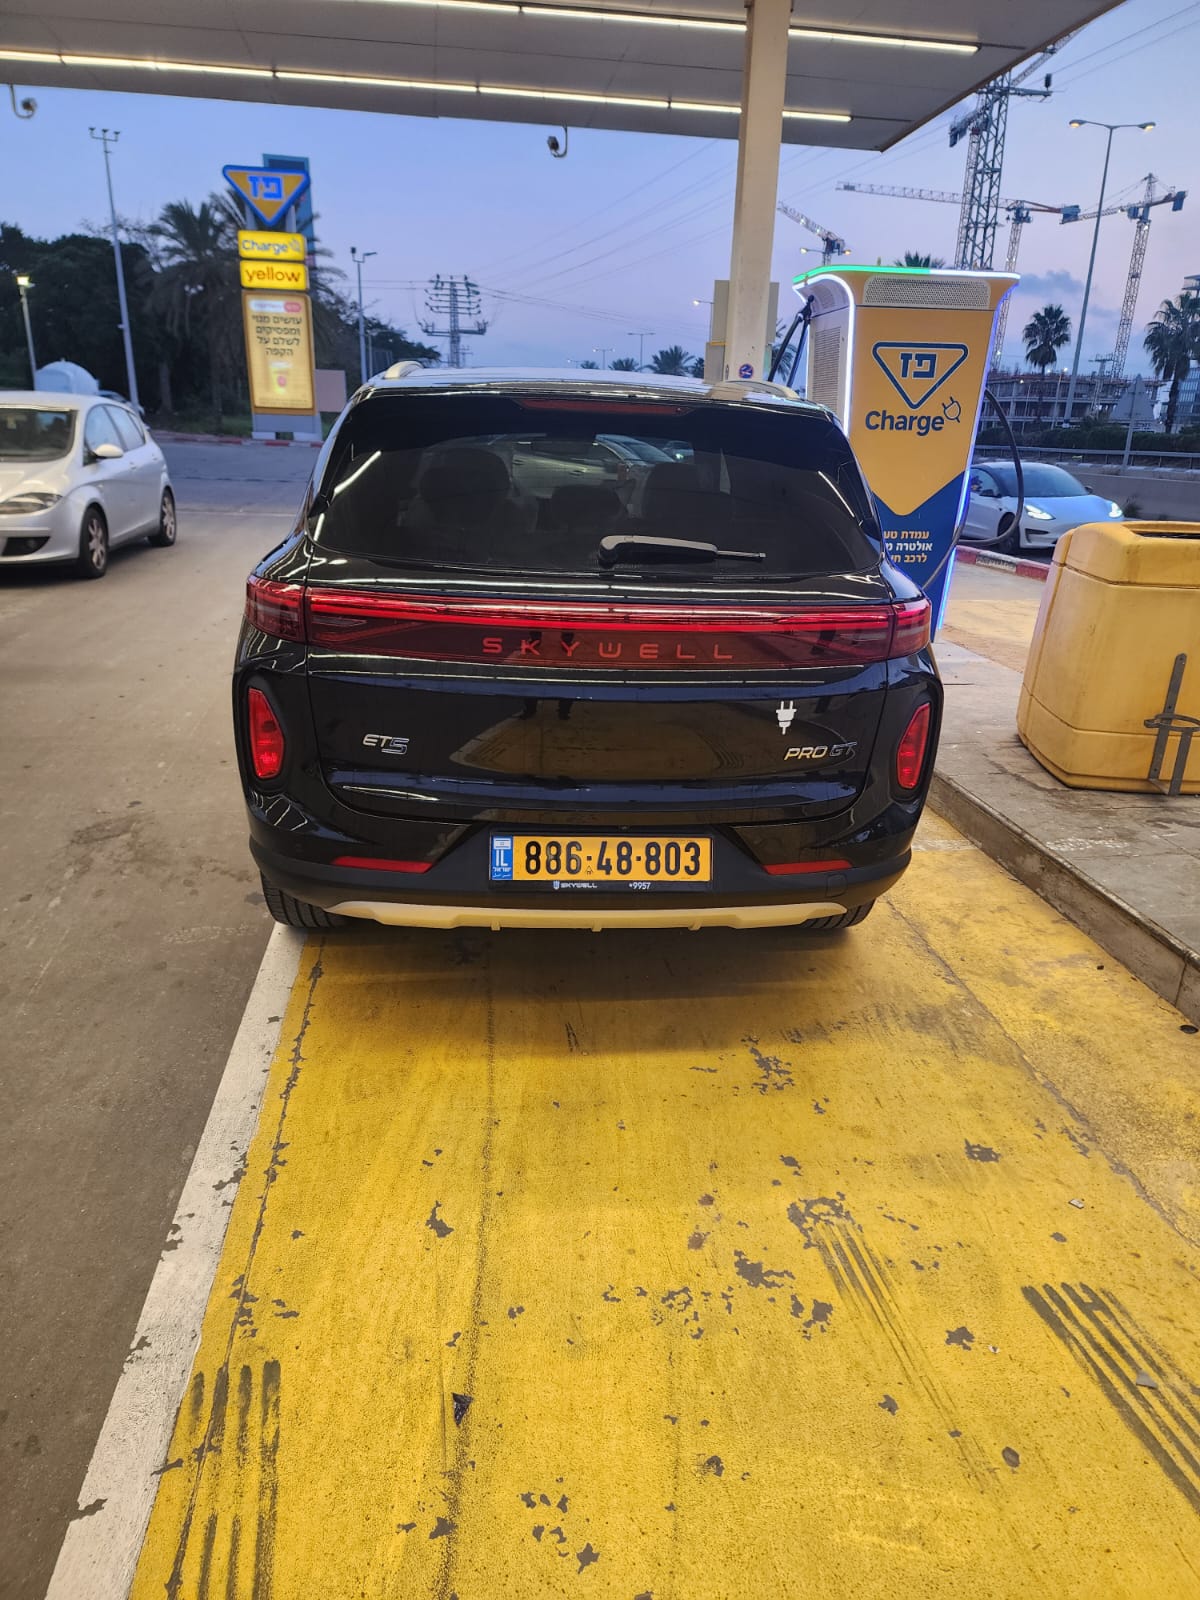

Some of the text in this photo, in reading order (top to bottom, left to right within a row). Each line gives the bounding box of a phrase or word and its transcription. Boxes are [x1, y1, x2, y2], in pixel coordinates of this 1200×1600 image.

[247, 175, 282, 199] פז
[242, 239, 288, 256] Charge
[244, 265, 301, 283] yellow
[256, 335, 300, 346] לשלם על
[900, 352, 937, 379] פז
[865, 410, 945, 436] Charge
[900, 530, 930, 540] עמדת
[895, 540, 933, 552] אולטרה
[903, 552, 928, 563] לרכב
[482, 637, 733, 661] SKYWELL
[362, 733, 410, 755] ET5
[783, 741, 858, 761] PRO GT
[495, 849, 509, 867] IL
